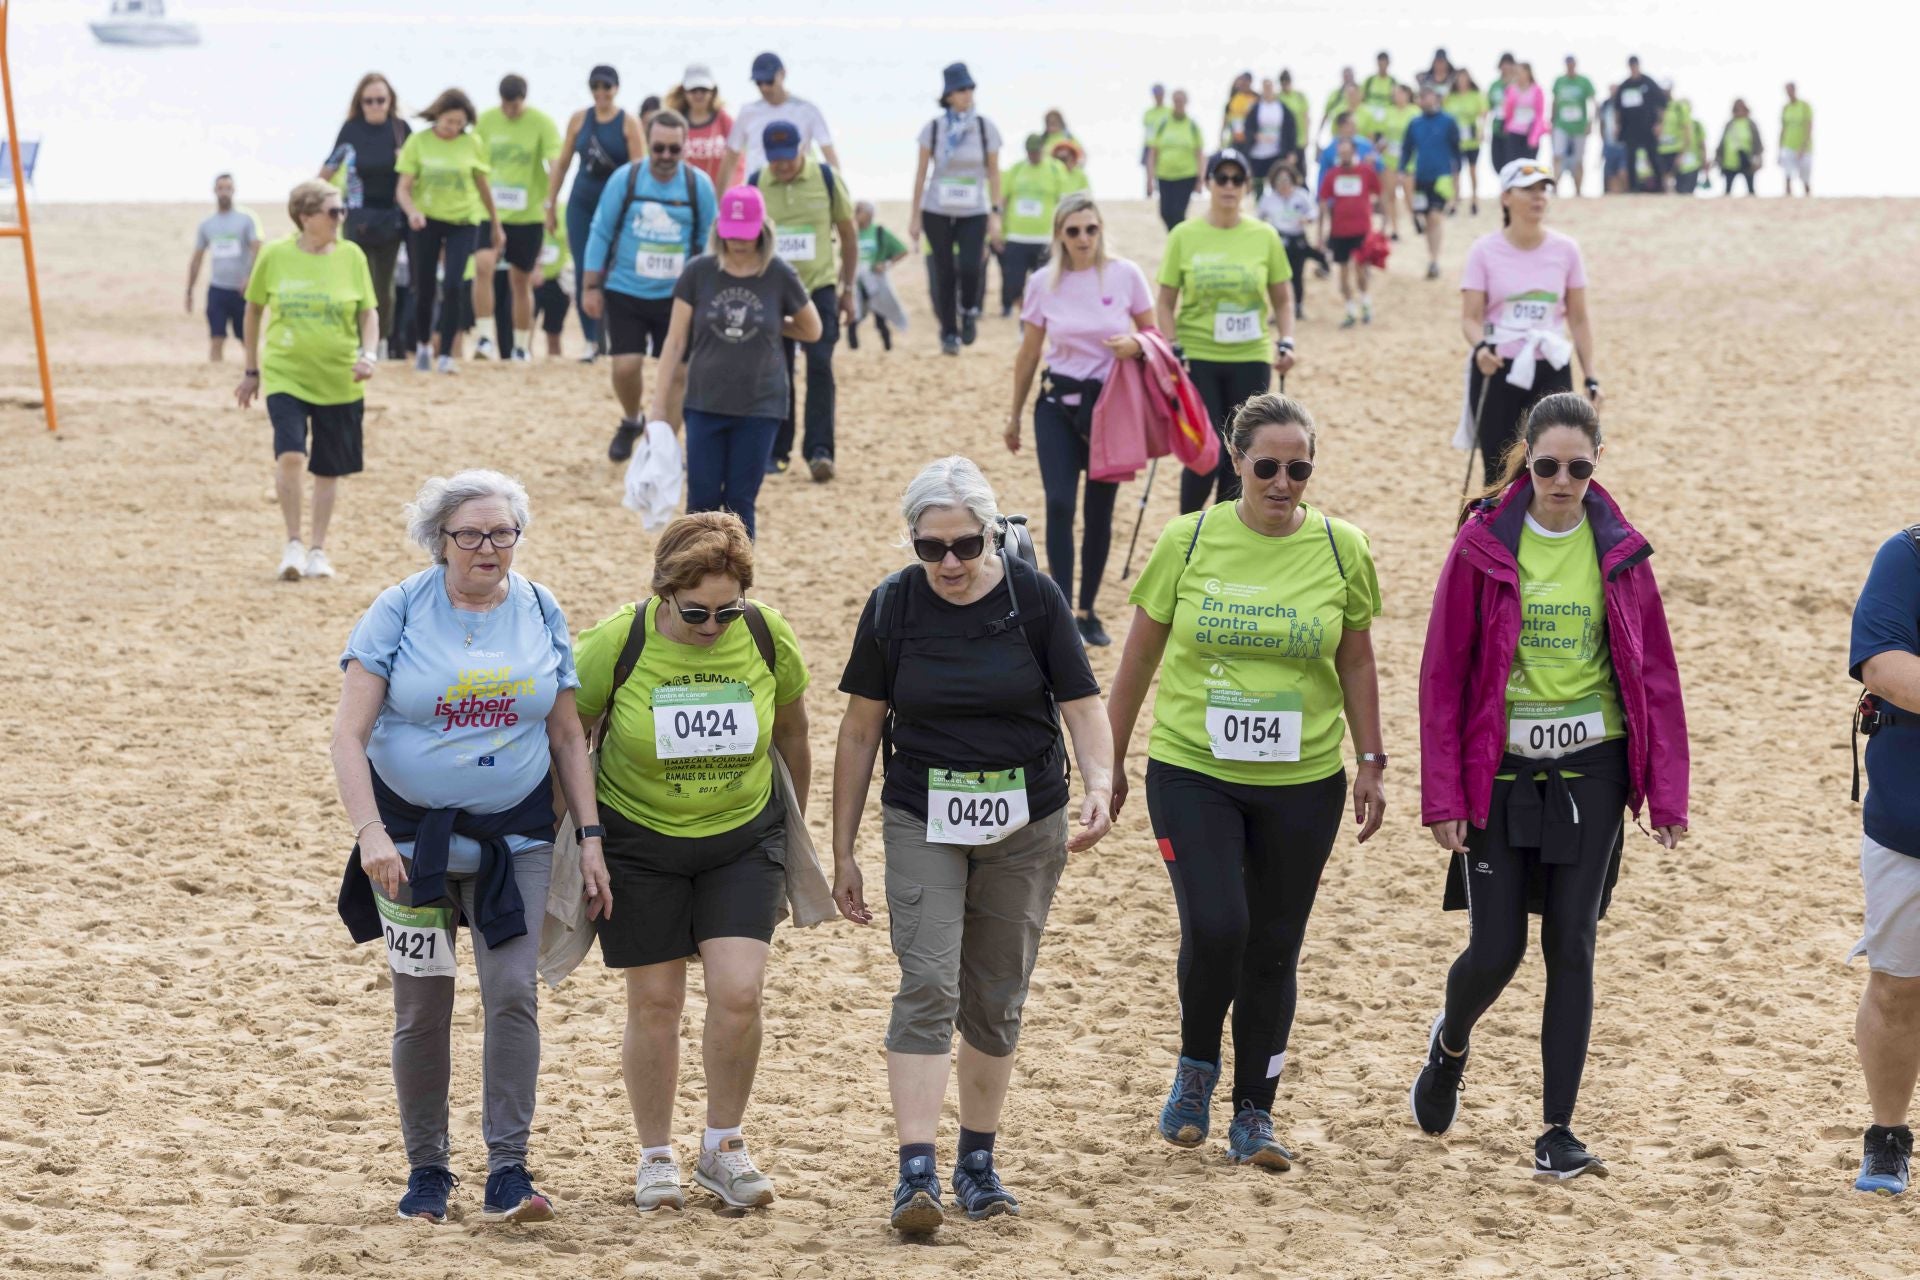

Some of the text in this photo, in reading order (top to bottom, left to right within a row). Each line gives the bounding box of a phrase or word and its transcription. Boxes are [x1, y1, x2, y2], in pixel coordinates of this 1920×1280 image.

[1201, 597, 1298, 618] En marcha
[1527, 601, 1591, 617] marcha
[1197, 615, 1258, 631] contra
[1521, 617, 1556, 632] ntra
[1195, 630, 1284, 648] el cáncer
[1520, 633, 1579, 649] cáncer
[458, 665, 513, 685] your
[445, 675, 537, 705] present
[434, 691, 515, 716] is their
[442, 710, 519, 731] future
[674, 708, 738, 739] 0424
[1224, 715, 1281, 743] 0154
[1529, 721, 1588, 750] 0100
[670, 757, 707, 765] MARCHA
[711, 755, 755, 763] SOLIDARIA
[665, 772, 696, 781] RAMALES
[698, 772, 706, 780] DE
[708, 772, 716, 780] LA
[948, 797, 1009, 826] 0420
[386, 925, 436, 959] 0421
